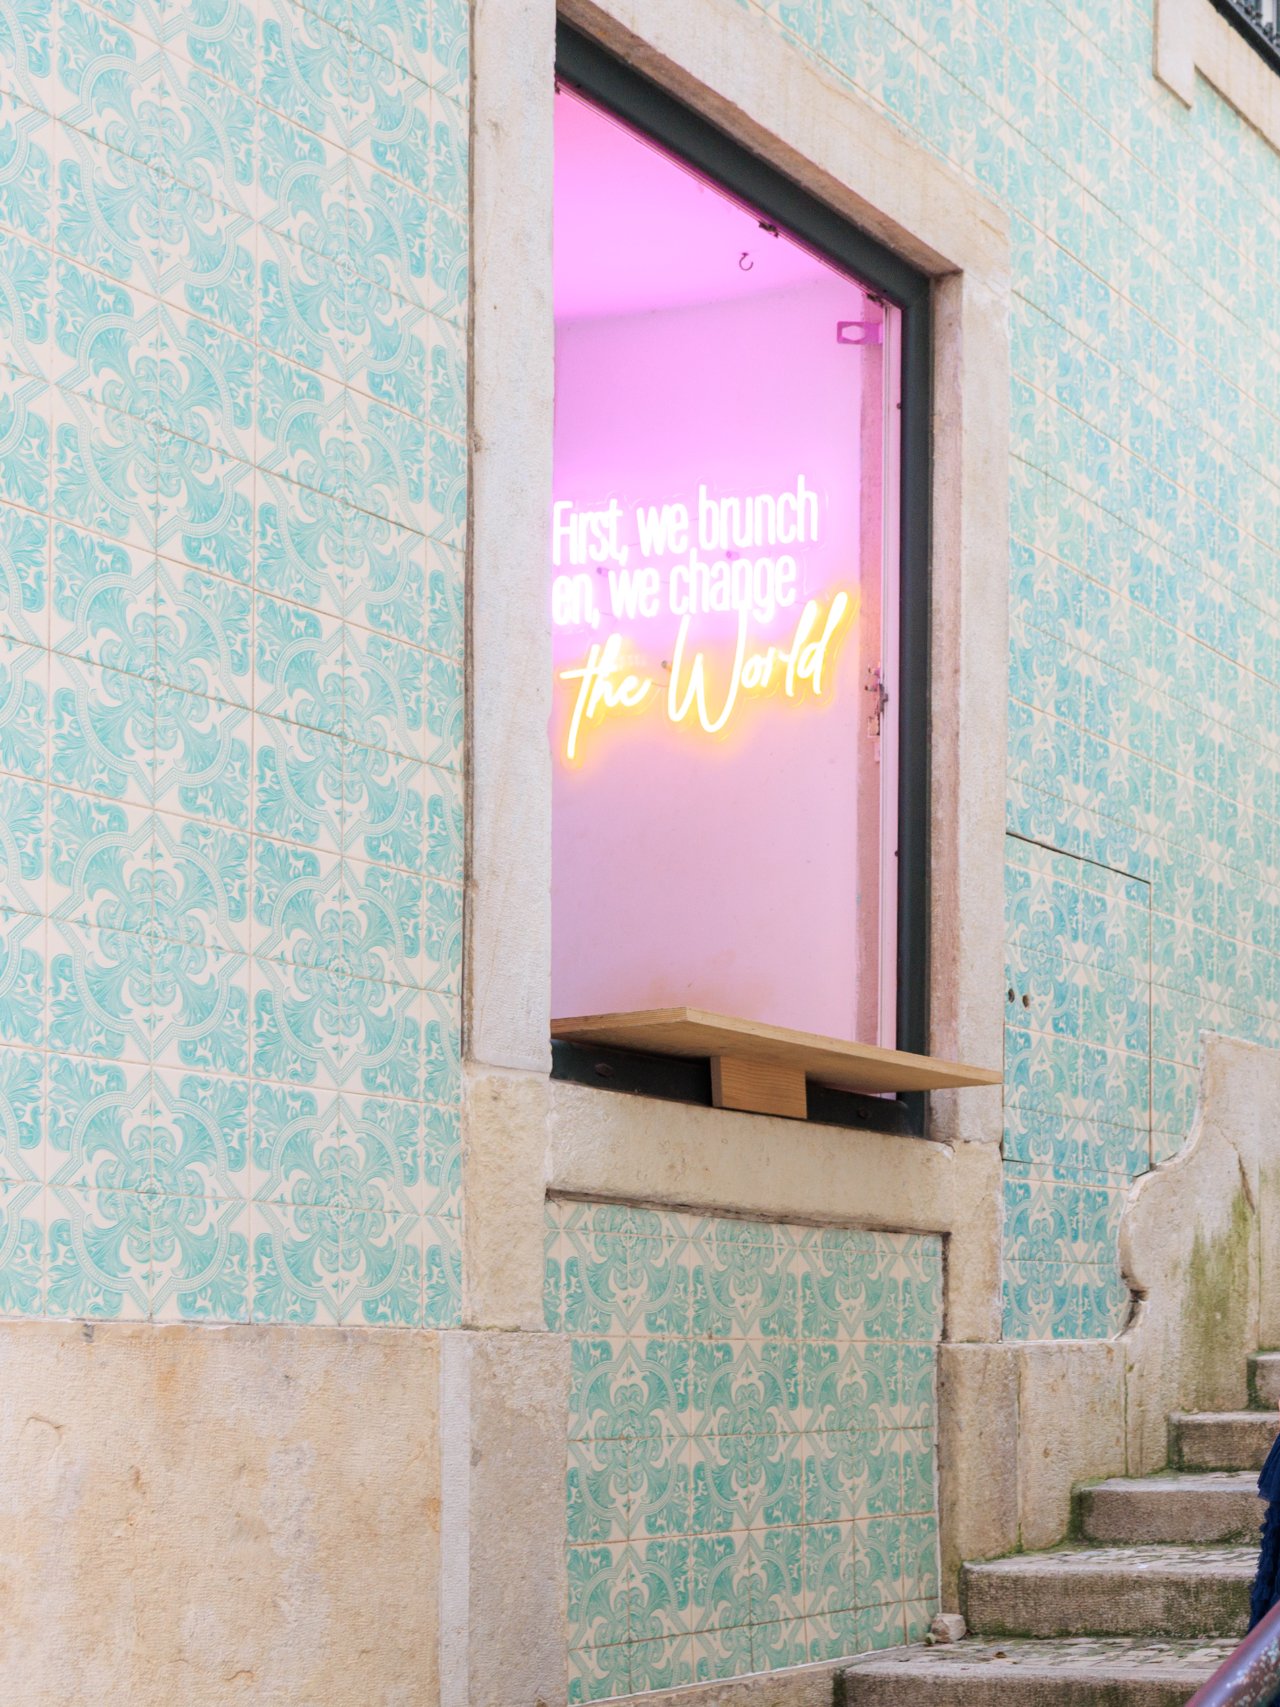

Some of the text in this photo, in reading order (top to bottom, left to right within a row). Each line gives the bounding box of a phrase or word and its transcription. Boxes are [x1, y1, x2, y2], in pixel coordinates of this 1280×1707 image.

[552, 474, 819, 567] First, we brunch
[551, 547, 797, 630] en, we change
[559, 591, 848, 760] the World
